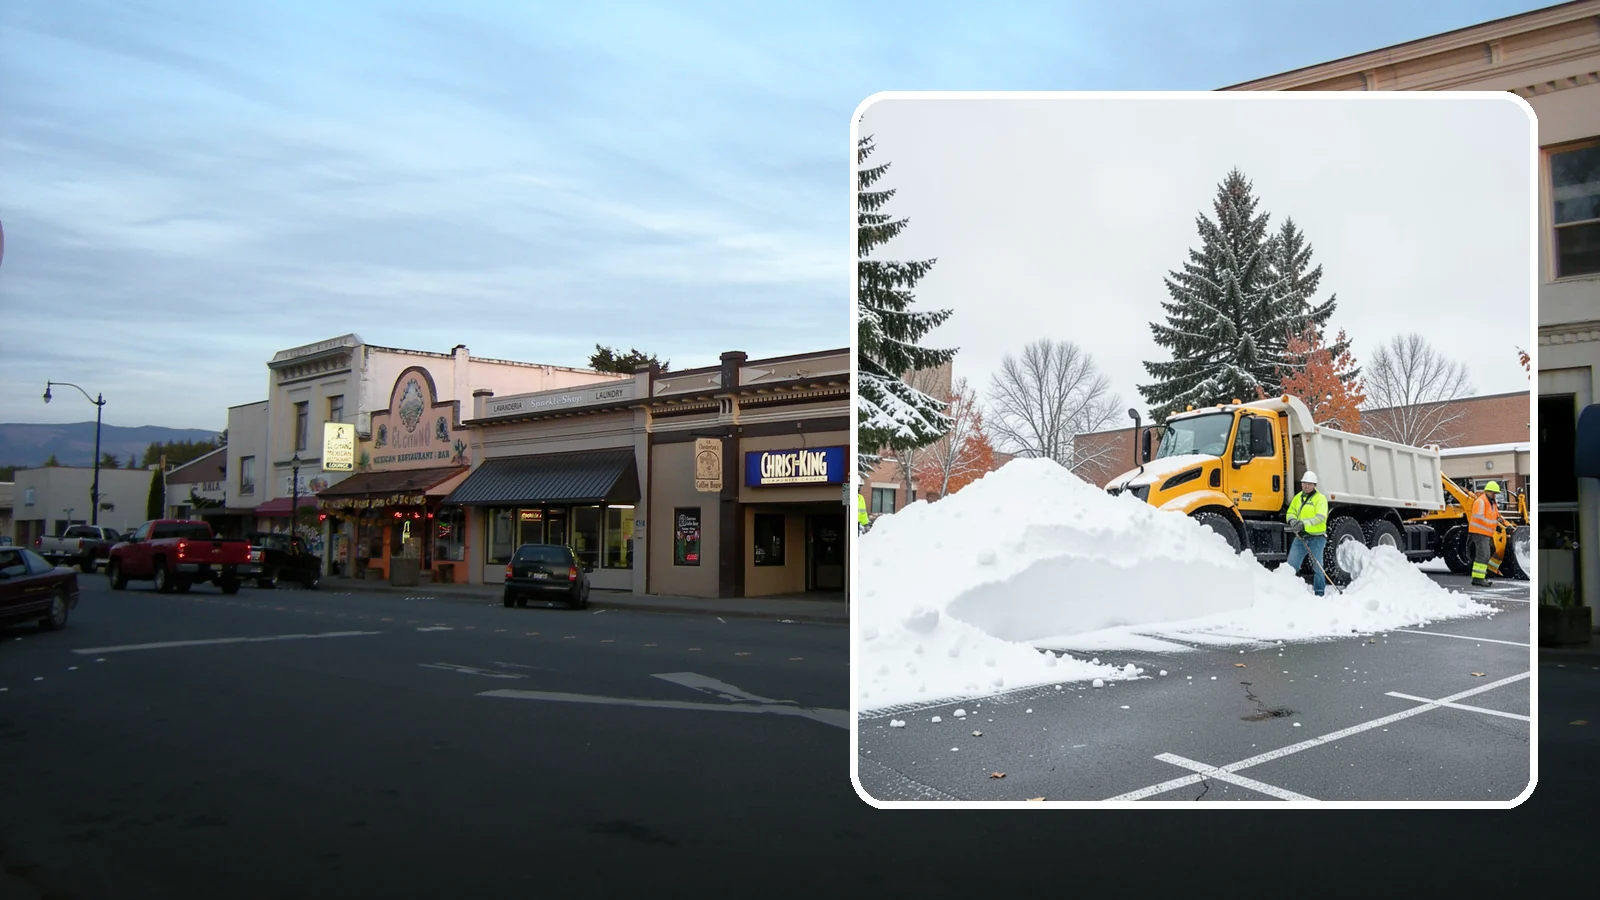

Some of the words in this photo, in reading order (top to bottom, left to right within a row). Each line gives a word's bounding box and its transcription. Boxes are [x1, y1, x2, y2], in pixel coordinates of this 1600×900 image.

[595, 389, 623, 400] LAUNDRY
[493, 402, 522, 413] LAVANDERIA
[373, 455, 397, 464] MEXICAN
[397, 451, 433, 462] RESTAURANT
[437, 450, 450, 459] BAR
[799, 450, 827, 476] KING
